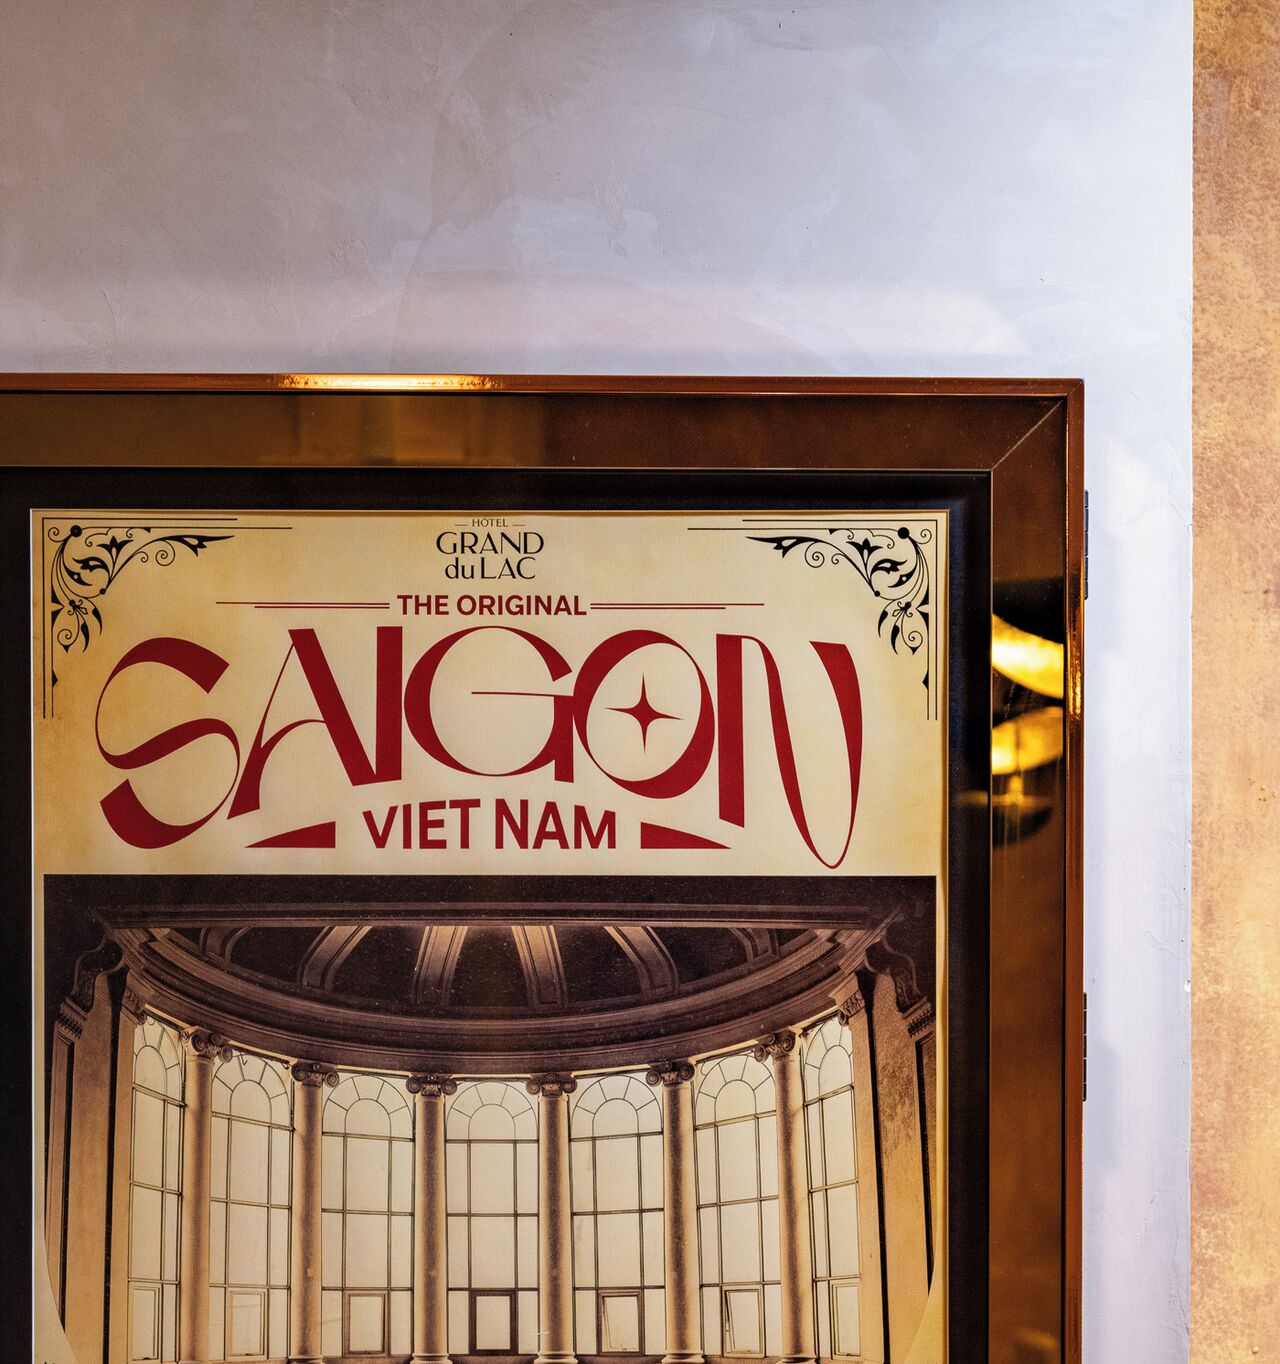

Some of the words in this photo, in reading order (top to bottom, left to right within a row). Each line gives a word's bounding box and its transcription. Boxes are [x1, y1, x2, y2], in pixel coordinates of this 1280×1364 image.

[471, 517, 509, 528] HÔTEL
[436, 531, 544, 555] GRAND
[396, 594, 449, 616] THE
[456, 594, 588, 616] ORIGINAL
[93, 625, 863, 870] SAIGON
[362, 798, 480, 851] VIET
[495, 798, 617, 851] NAM
